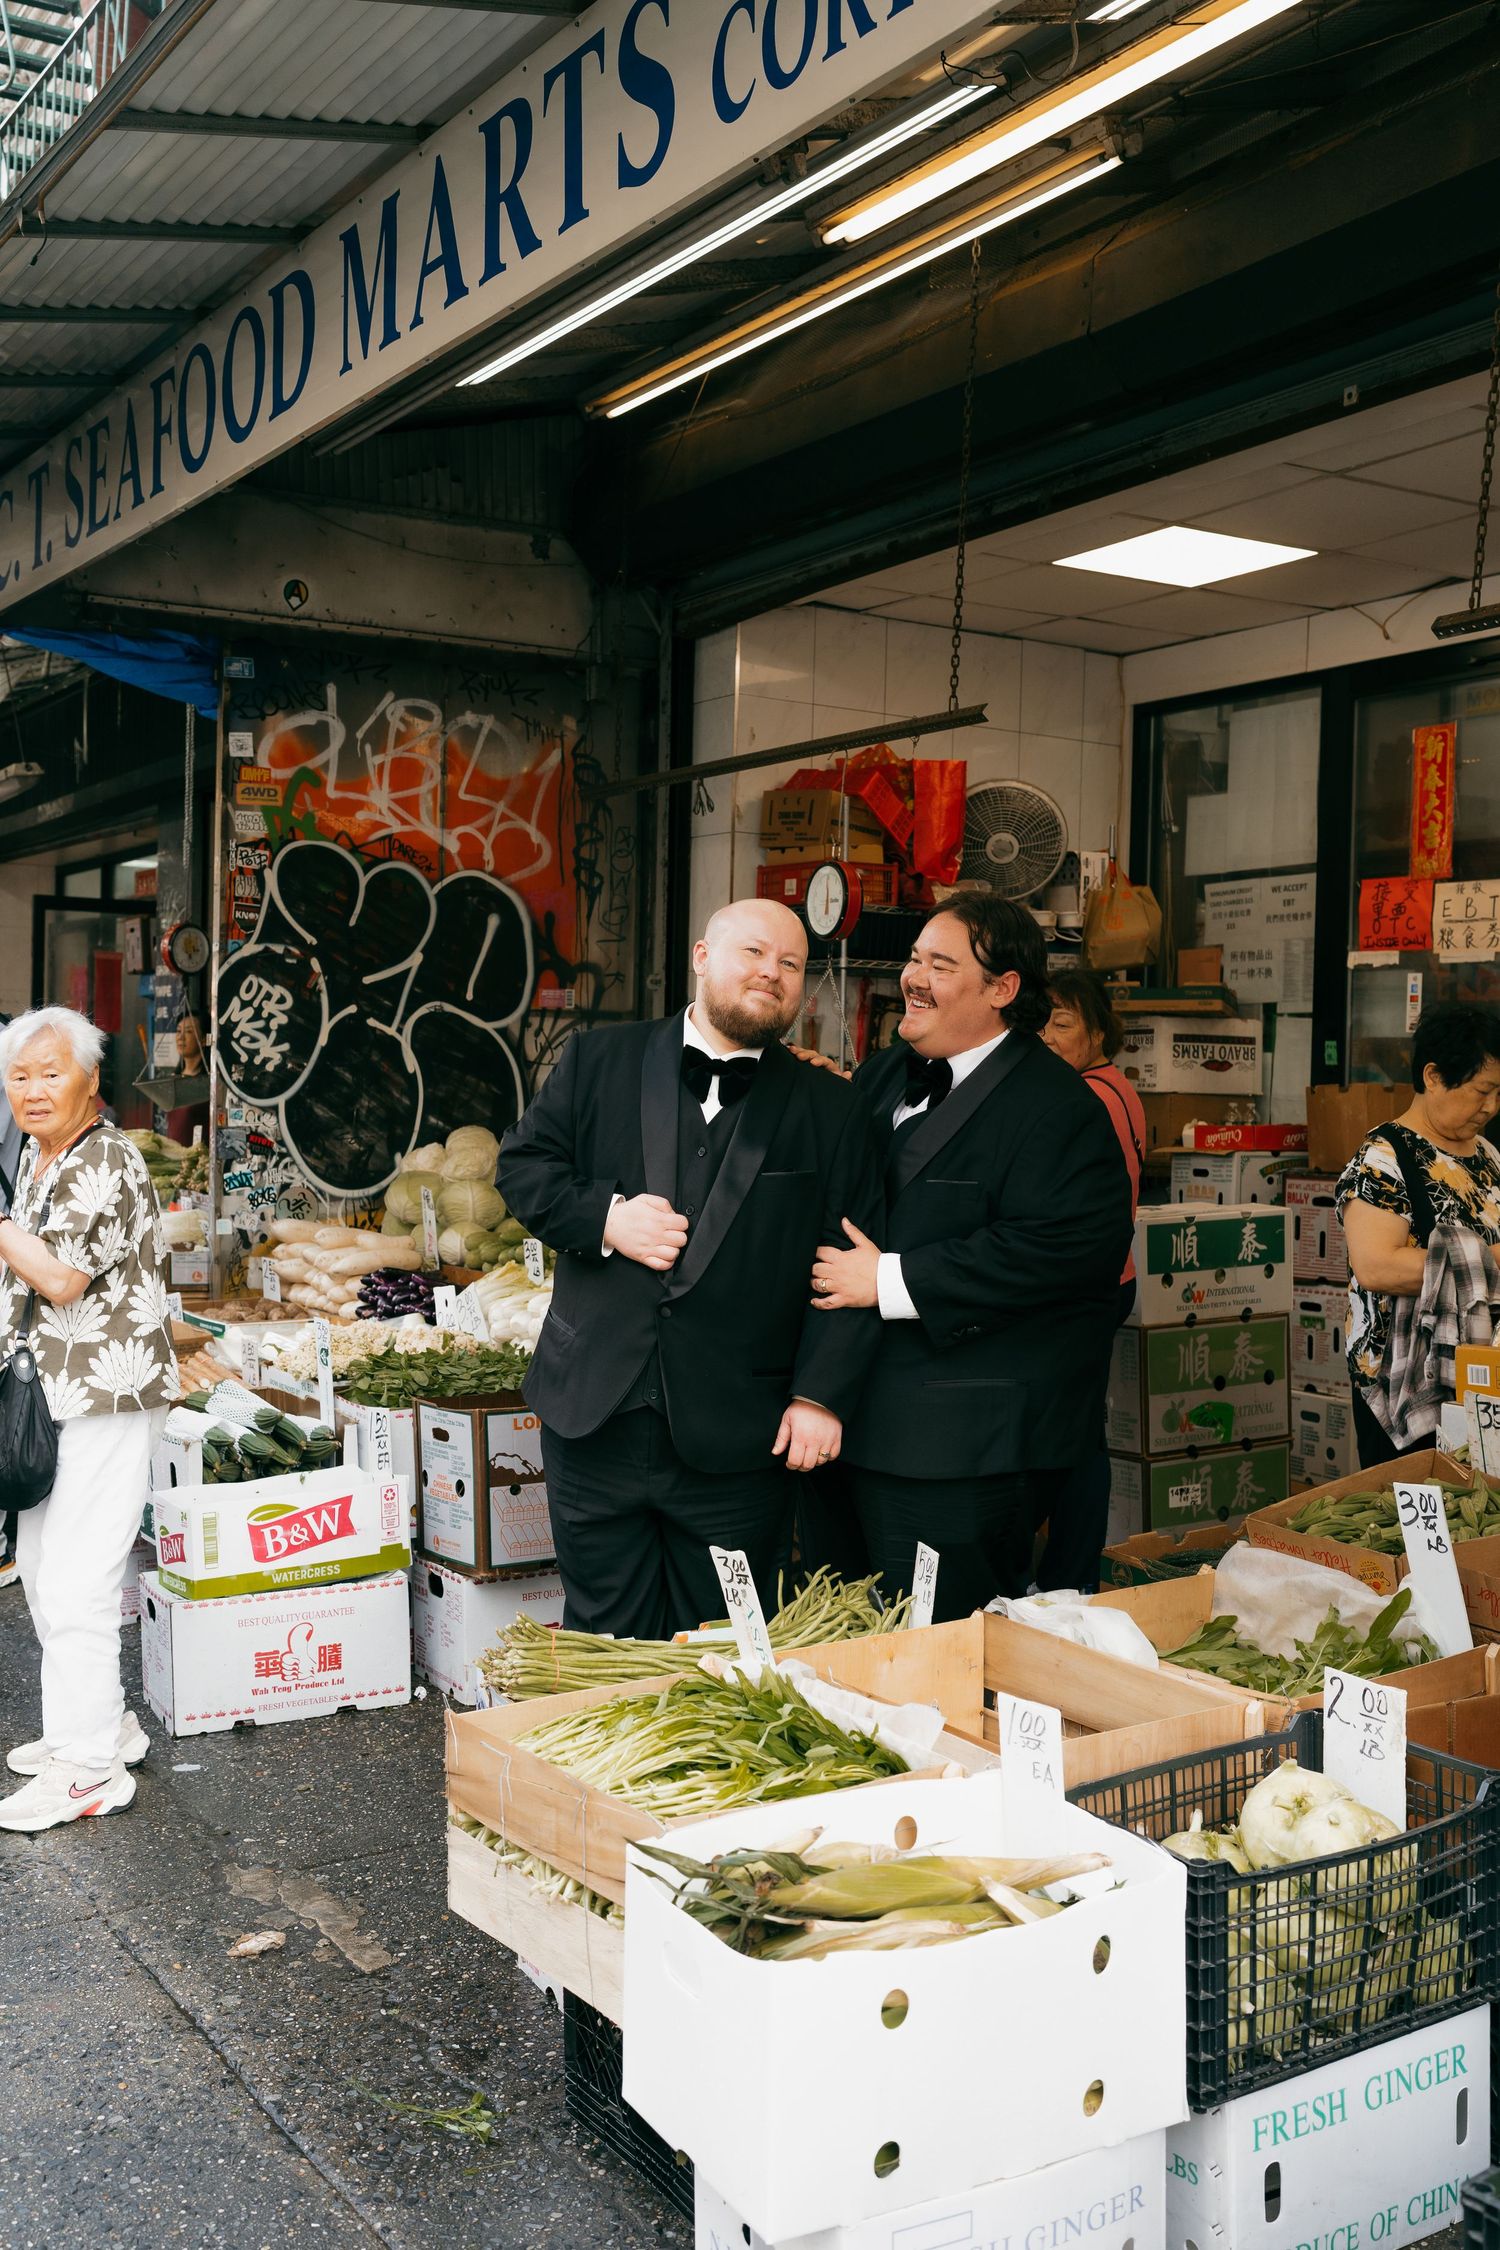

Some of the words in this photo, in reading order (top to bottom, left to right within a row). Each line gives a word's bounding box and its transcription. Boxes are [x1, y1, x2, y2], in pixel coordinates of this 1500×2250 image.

[64, 270, 316, 549] SEAFOOD
[338, 0, 675, 377] MARTS
[240, 786, 278, 798] 4WD
[1271, 885, 1281, 894] WE
[1283, 883, 1308, 892] ACCEPT
[1283, 898, 1295, 907] EBT
[1364, 936, 1399, 948] INSIDE
[1402, 933, 1427, 948] ONLY
[1172, 1044, 1215, 1060] FARMS
[1219, 1046, 1256, 1061] BRAVO
[378, 1452, 390, 1470] EA
[260, 1503, 343, 1560] B&W
[162, 1538, 181, 1562] B&W
[271, 1563, 341, 1585] WATERCRESS
[522, 1592, 543, 1602] BEST
[543, 1588, 566, 1599] QUAL
[725, 1587, 742, 1607] LB
[237, 1617, 261, 1628] BEST
[262, 1613, 301, 1625] QUALITY
[302, 1607, 355, 1621] GUARANTEE
[251, 1687, 269, 1696] Wah
[271, 1684, 292, 1694] Teng
[295, 1680, 329, 1691] Produce
[331, 1677, 345, 1686] Ltd
[258, 1701, 284, 1712] FRESH
[286, 1695, 339, 1708] VEGETABLES
[1360, 1739, 1385, 1760] LB
[1032, 1761, 1055, 1789] EA
[1252, 2087, 1349, 2153] FRESH
[1364, 2044, 1469, 2112] GINGER
[1166, 2153, 1199, 2186] BS
[1025, 2184, 1146, 2250] GINGER
[1370, 2205, 1399, 2242] OF
[1406, 2174, 1470, 2226] CHIN
